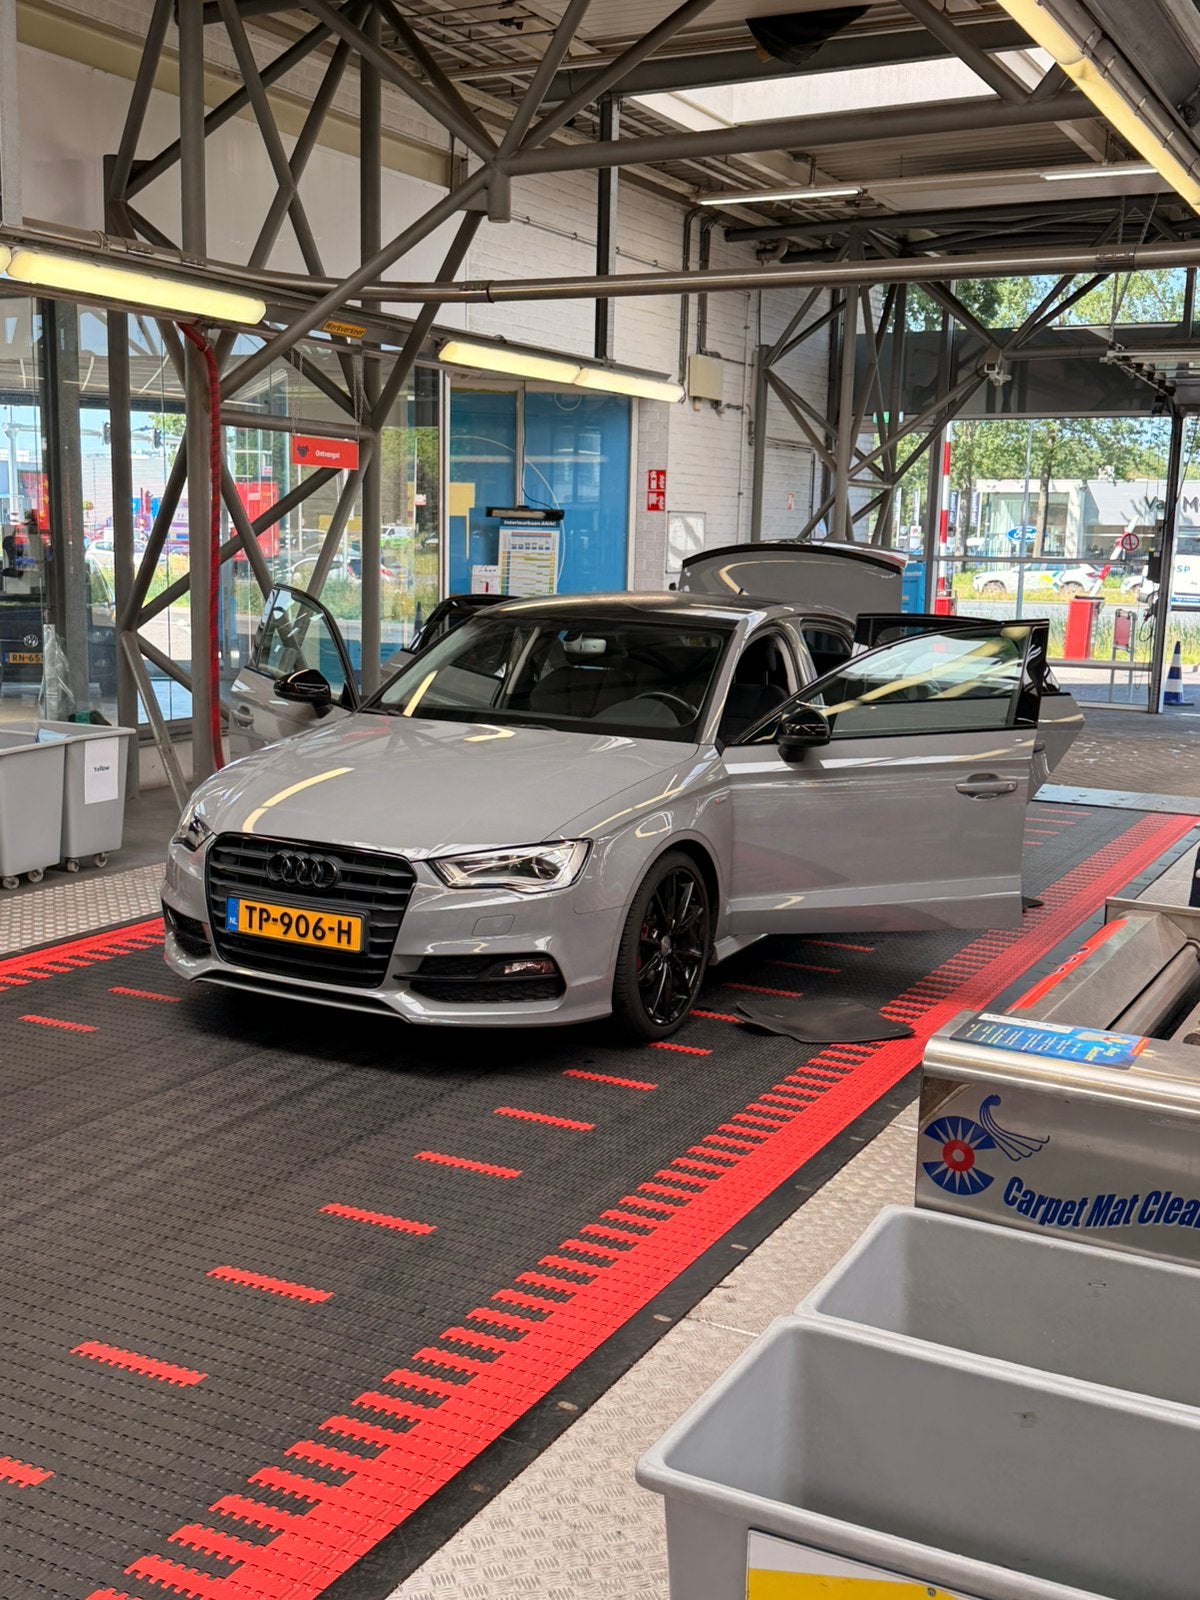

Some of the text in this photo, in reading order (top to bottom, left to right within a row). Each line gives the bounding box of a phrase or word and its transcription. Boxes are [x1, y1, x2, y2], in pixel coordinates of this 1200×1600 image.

[1144, 495, 1200, 513] Va M
[11, 653, 44, 662] RN-65
[229, 917, 238, 926] NL
[245, 905, 352, 945] TP-906-H
[1003, 1176, 1088, 1227] Carpet
[1085, 1194, 1140, 1227] Mat
